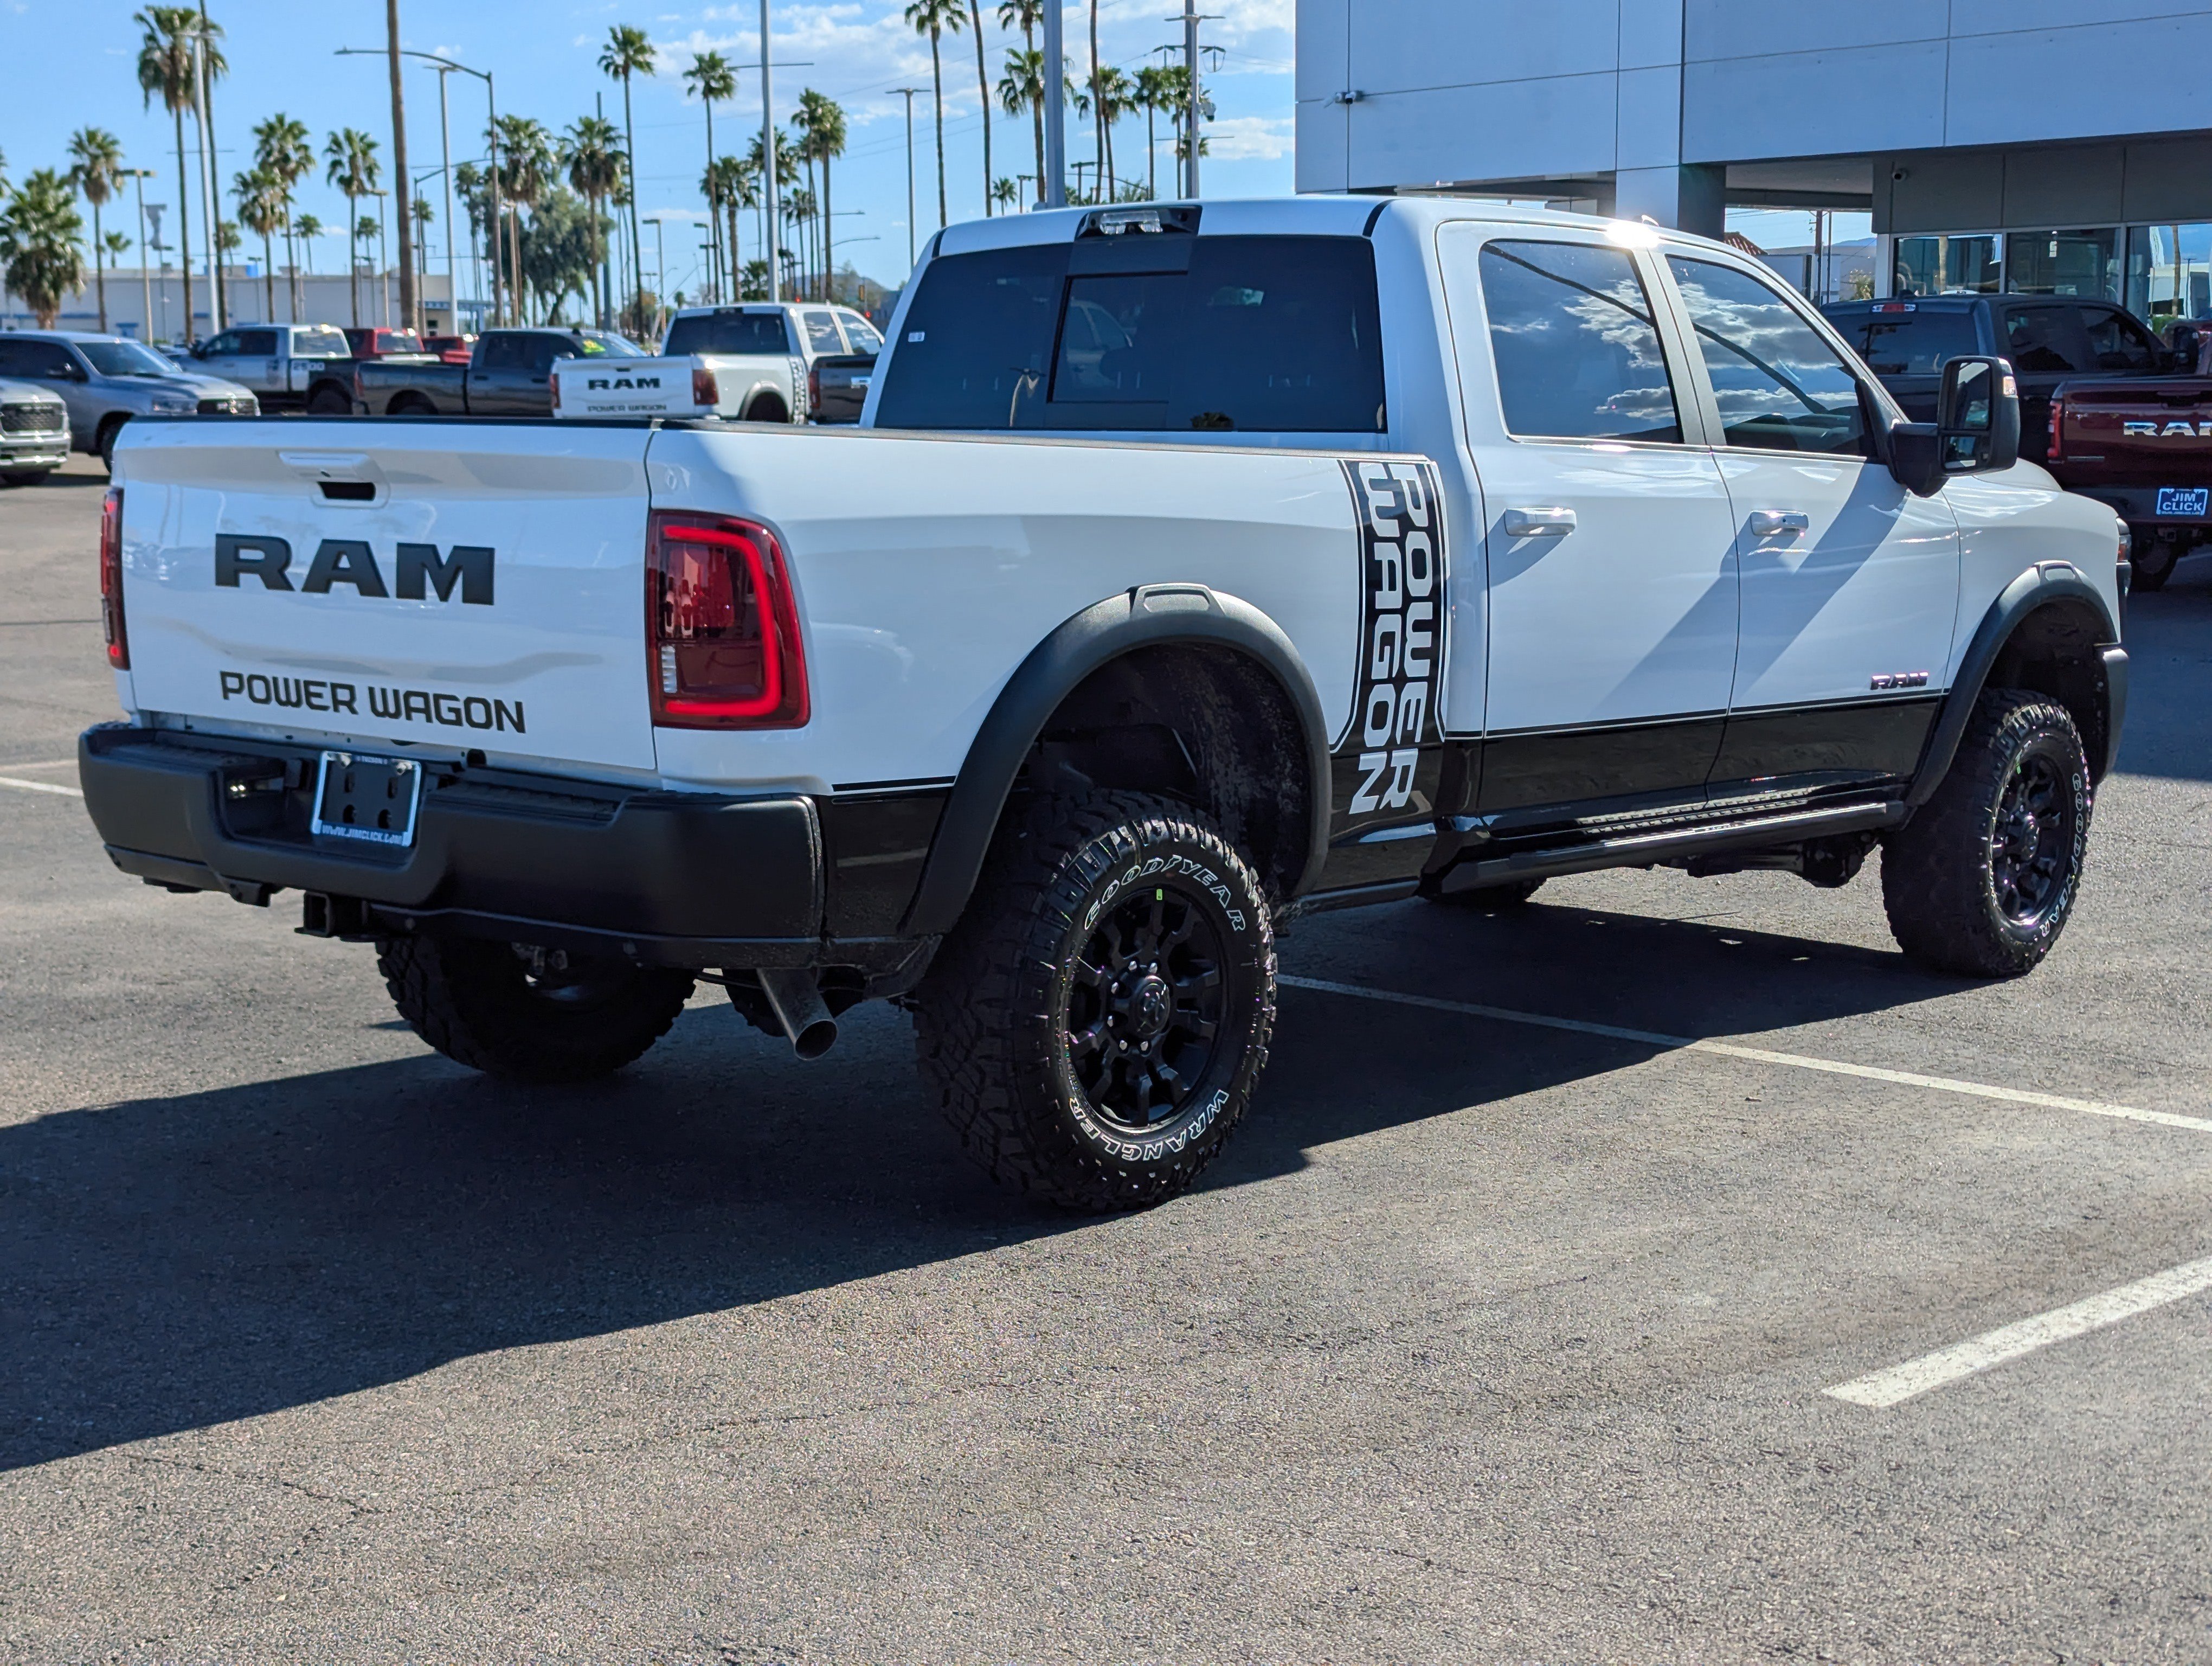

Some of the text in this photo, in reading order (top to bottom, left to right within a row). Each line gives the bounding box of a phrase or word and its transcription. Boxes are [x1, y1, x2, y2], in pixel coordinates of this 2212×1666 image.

[588, 377, 660, 390] RAM
[2162, 502, 2202, 511] CLICK
[2172, 493, 2196, 502] JIM
[215, 533, 495, 606] RAM
[1349, 462, 1403, 815] WAGON
[1379, 463, 1433, 808] POWER
[220, 671, 526, 734] POWER WAGON
[1870, 672, 1928, 690] RAM
[2040, 773, 2084, 937] GOODYEAR
[1085, 855, 1246, 931] GOODYEAR
[1069, 1089, 1229, 1161] WRANGLER
